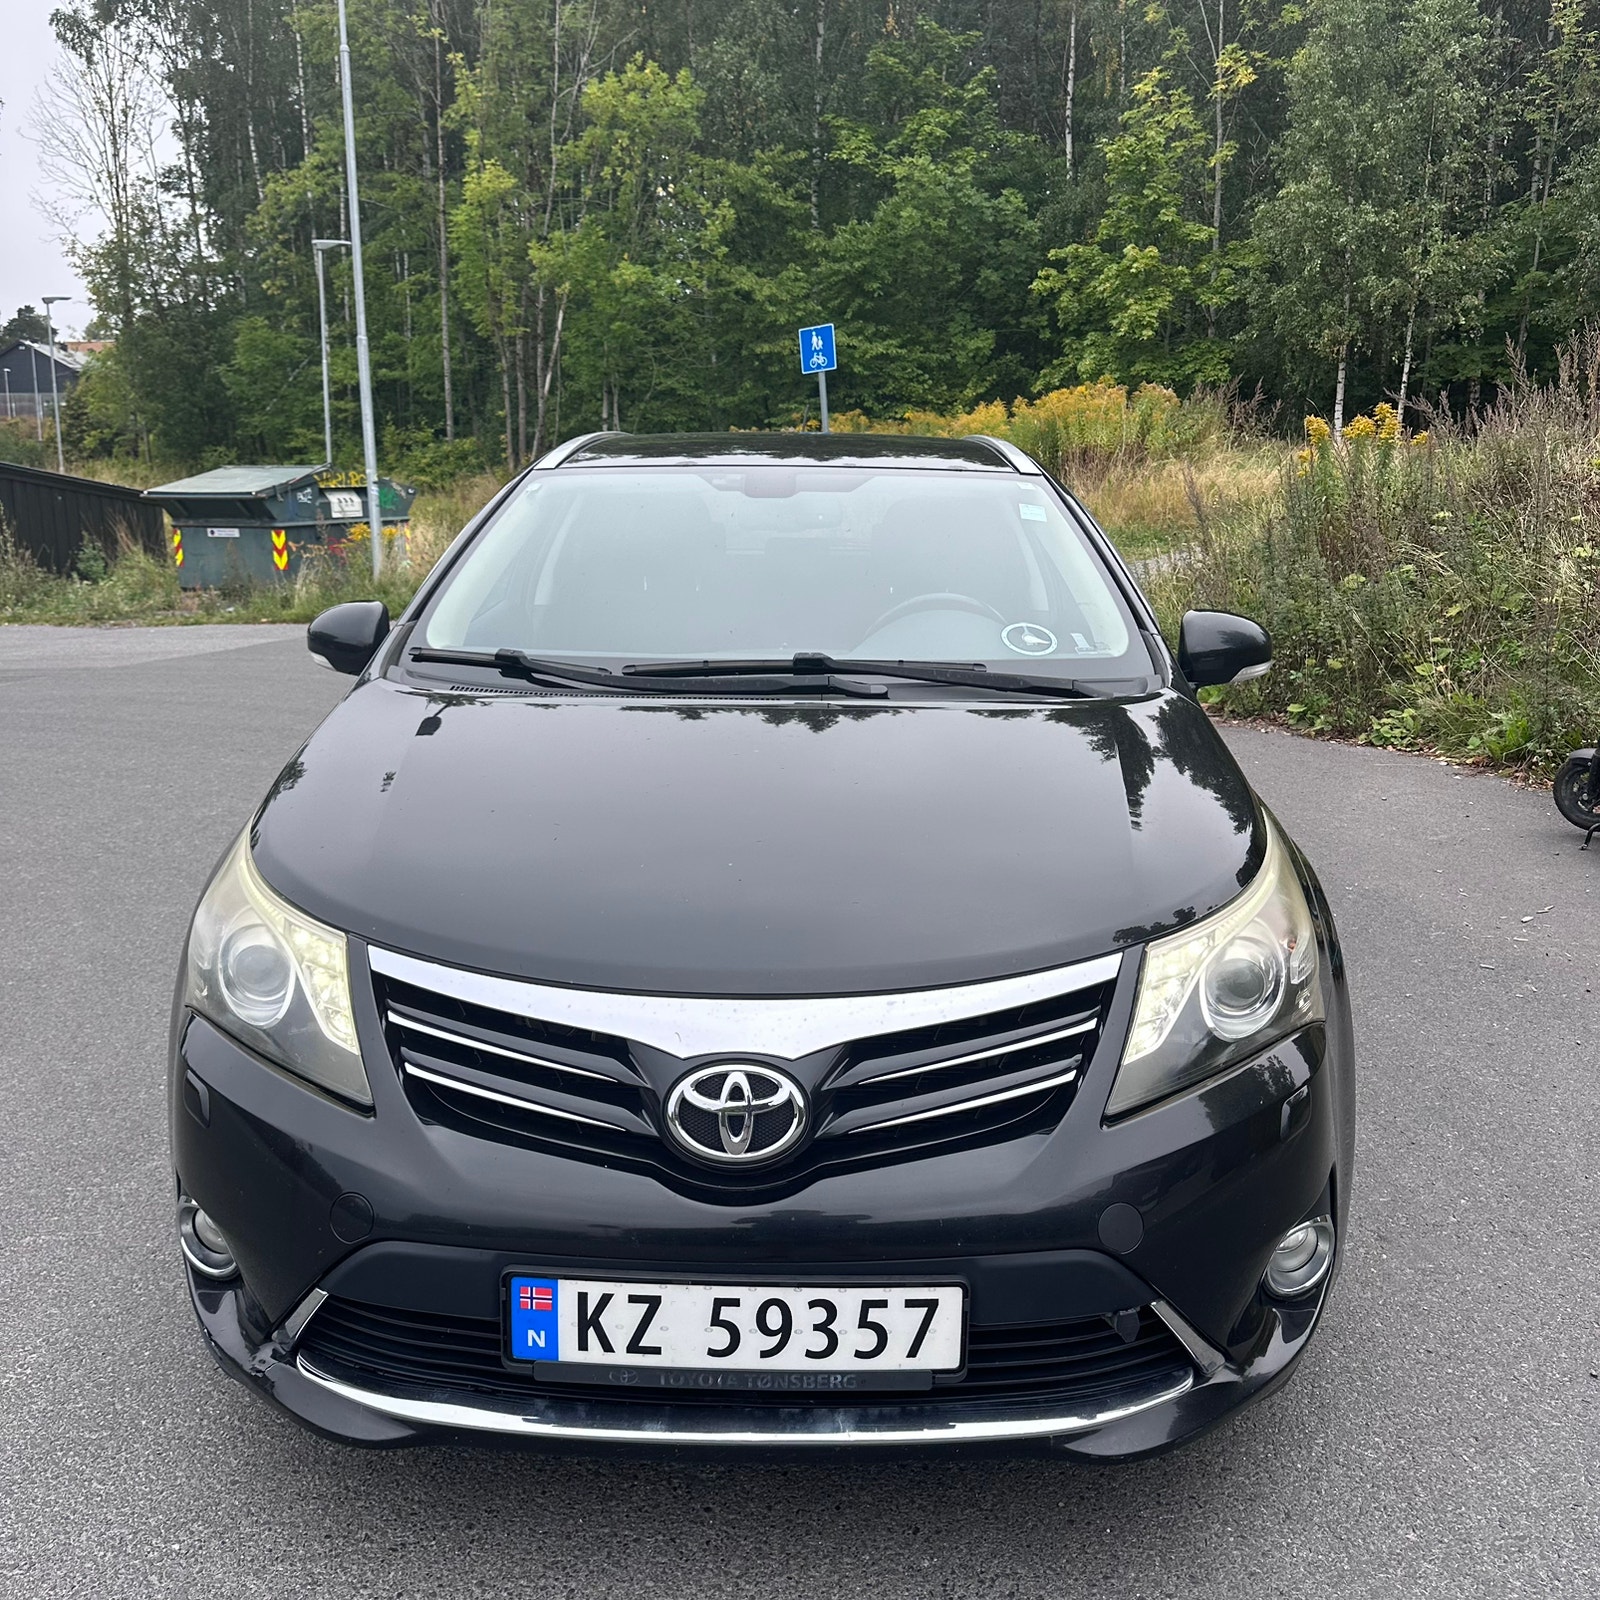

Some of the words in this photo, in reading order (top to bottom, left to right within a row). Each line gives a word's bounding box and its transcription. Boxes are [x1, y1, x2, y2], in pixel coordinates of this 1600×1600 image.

[577, 1291, 662, 1356] KZ
[706, 1297, 940, 1360] 59357
[527, 1329, 546, 1348] N
[657, 1373, 739, 1388] TOYOTA
[747, 1374, 857, 1389] TØNSBERG
